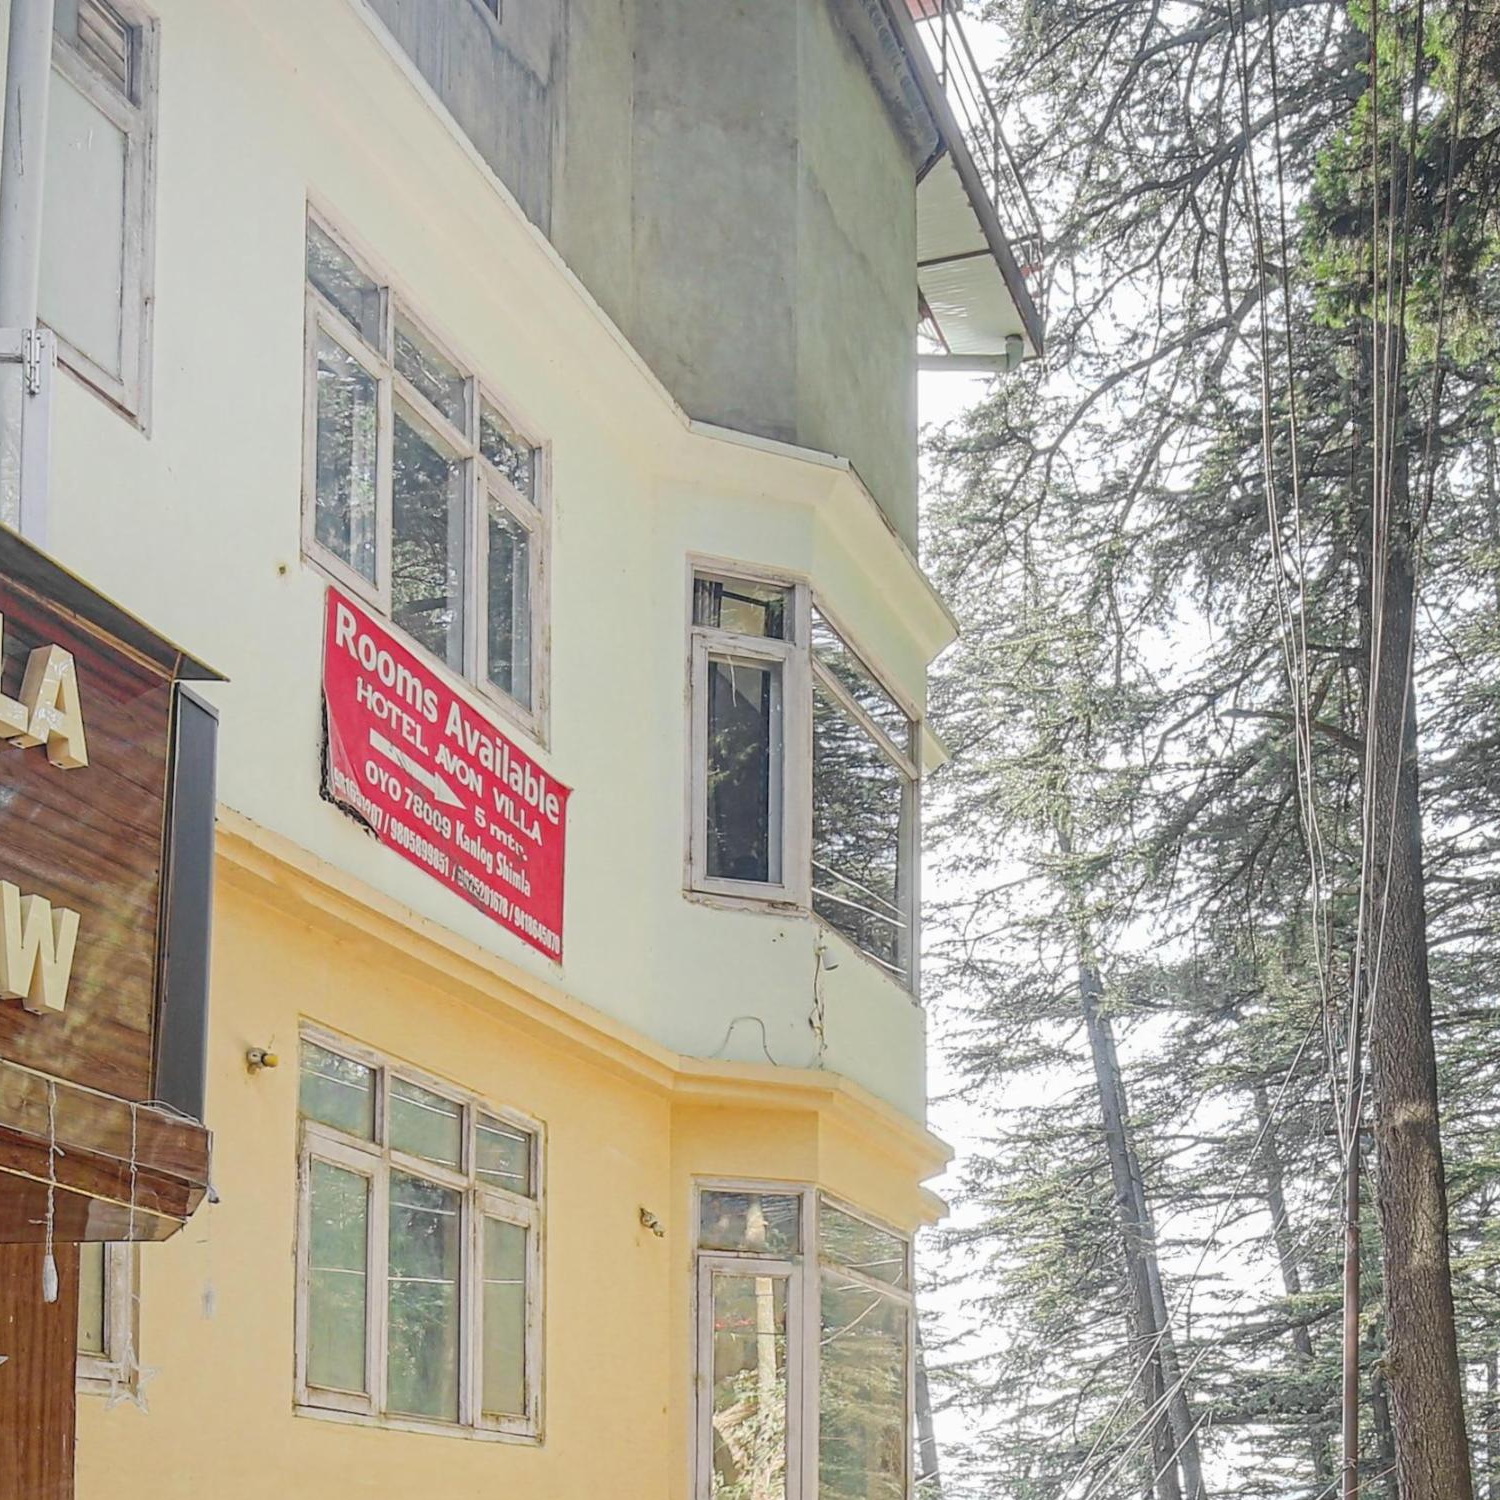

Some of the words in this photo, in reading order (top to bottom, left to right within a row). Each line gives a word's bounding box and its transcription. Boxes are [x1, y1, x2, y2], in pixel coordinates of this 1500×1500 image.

[336, 602, 438, 723] Rooms
[445, 701, 559, 825] Available
[357, 677, 429, 755] HOTEL
[435, 744, 483, 798] AVON
[494, 788, 542, 846] VILLA
[366, 760, 401, 802] OYO
[405, 787, 451, 839] 78009
[456, 820, 493, 874] Kanlog
[496, 851, 531, 897] Shimla
[475, 806, 486, 828] 5
